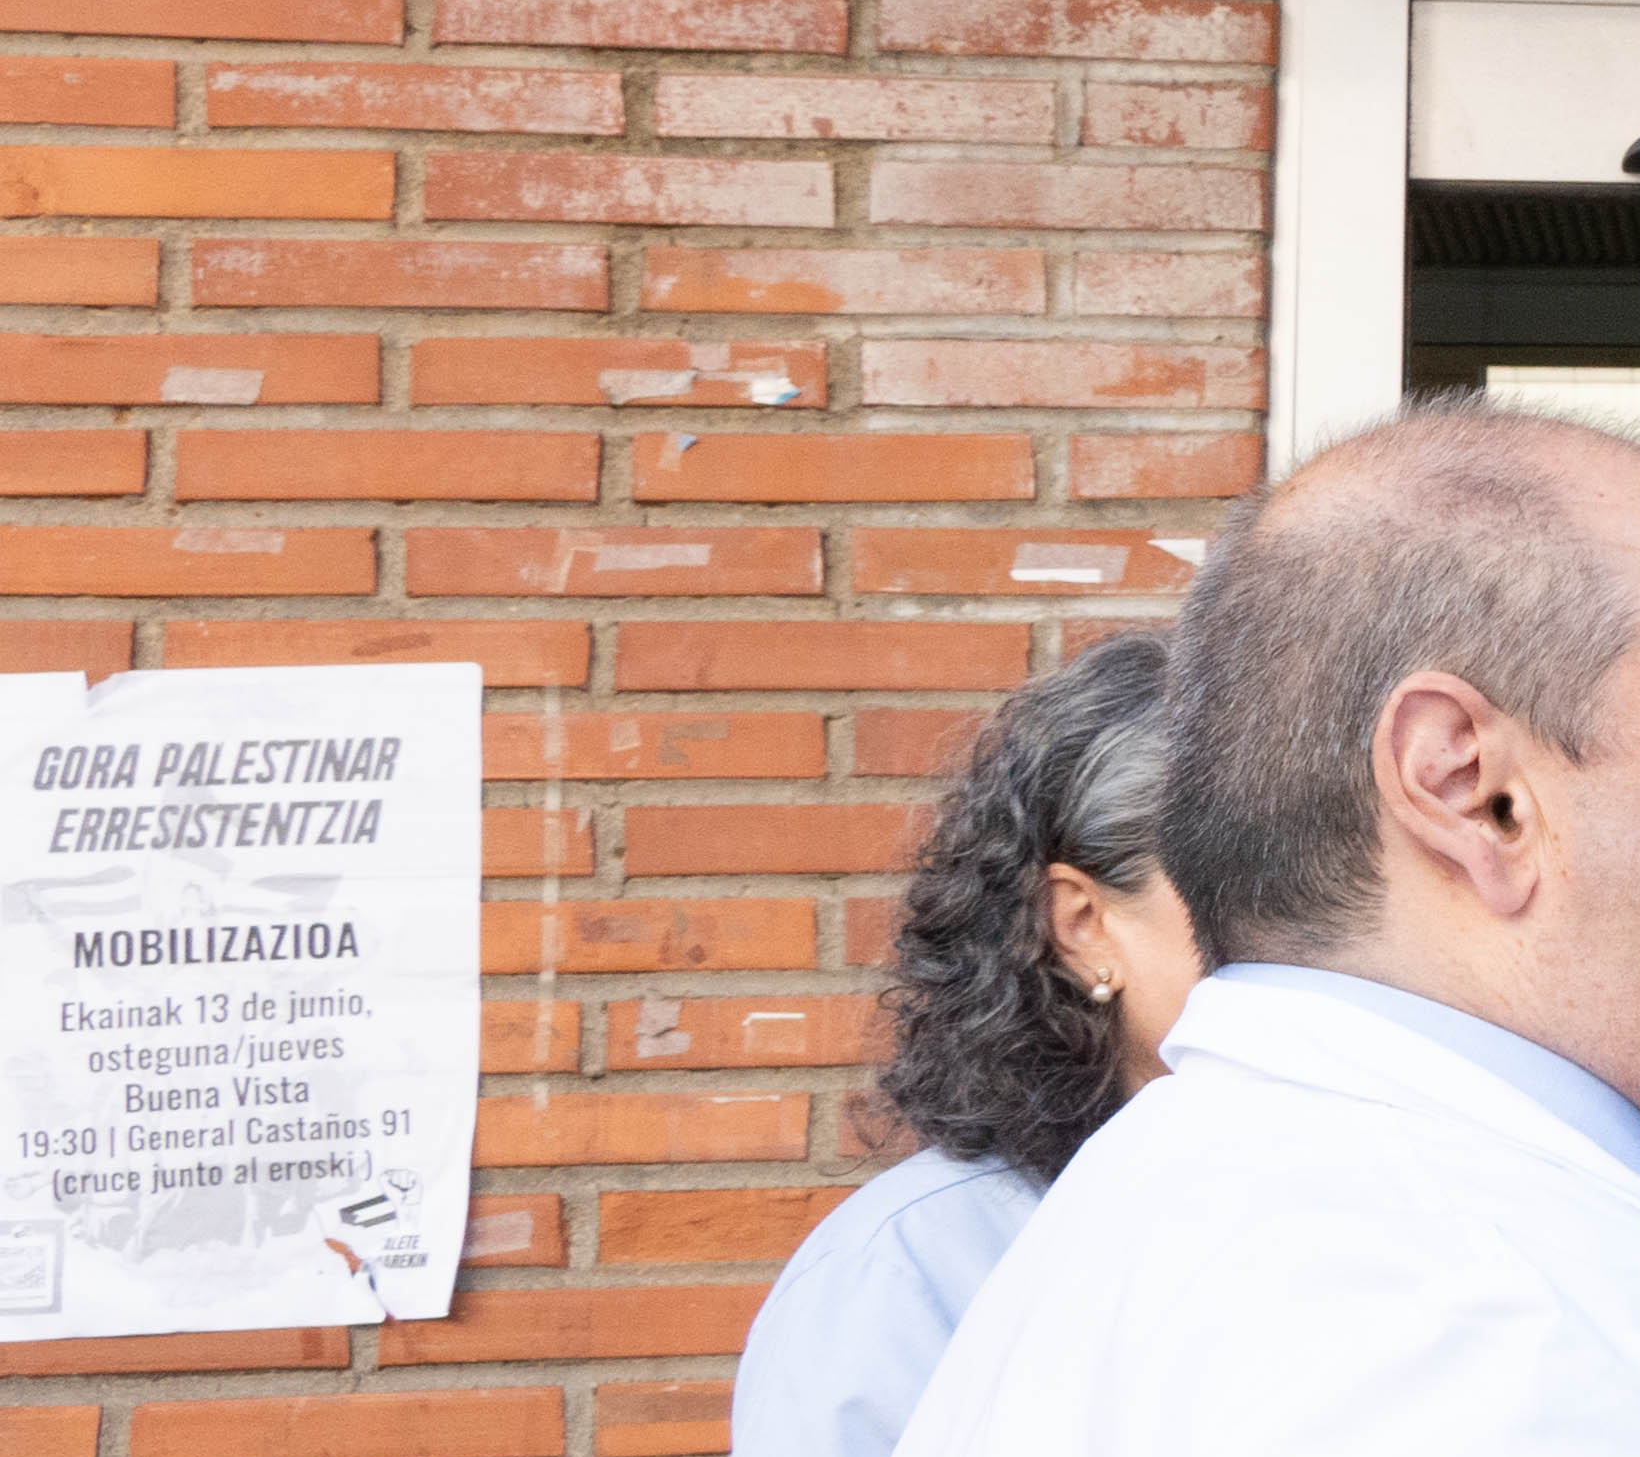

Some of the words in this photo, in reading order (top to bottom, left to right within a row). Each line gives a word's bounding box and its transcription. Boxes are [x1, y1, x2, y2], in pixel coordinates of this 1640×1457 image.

[33, 743, 141, 791] GORA
[154, 737, 403, 788] PALESTINAR
[49, 798, 384, 855] ERRESISTENTZIA
[74, 922, 360, 969] MOBILIZAZIOA
[61, 995, 183, 1033] Ekainak
[197, 994, 230, 1024] 13
[242, 990, 278, 1022] de
[287, 988, 374, 1023] junio,
[88, 1036, 345, 1075] osteguna/jueves
[125, 1081, 221, 1114] Buena
[233, 1077, 311, 1107] Vista
[18, 1127, 98, 1159] 19:30
[128, 1120, 237, 1153] General
[246, 1113, 372, 1146] Castaños
[382, 1109, 413, 1138] 91
[52, 1167, 142, 1202] (cruce
[150, 1158, 223, 1192] junto
[234, 1154, 259, 1185] al
[269, 1149, 356, 1181] eroski
